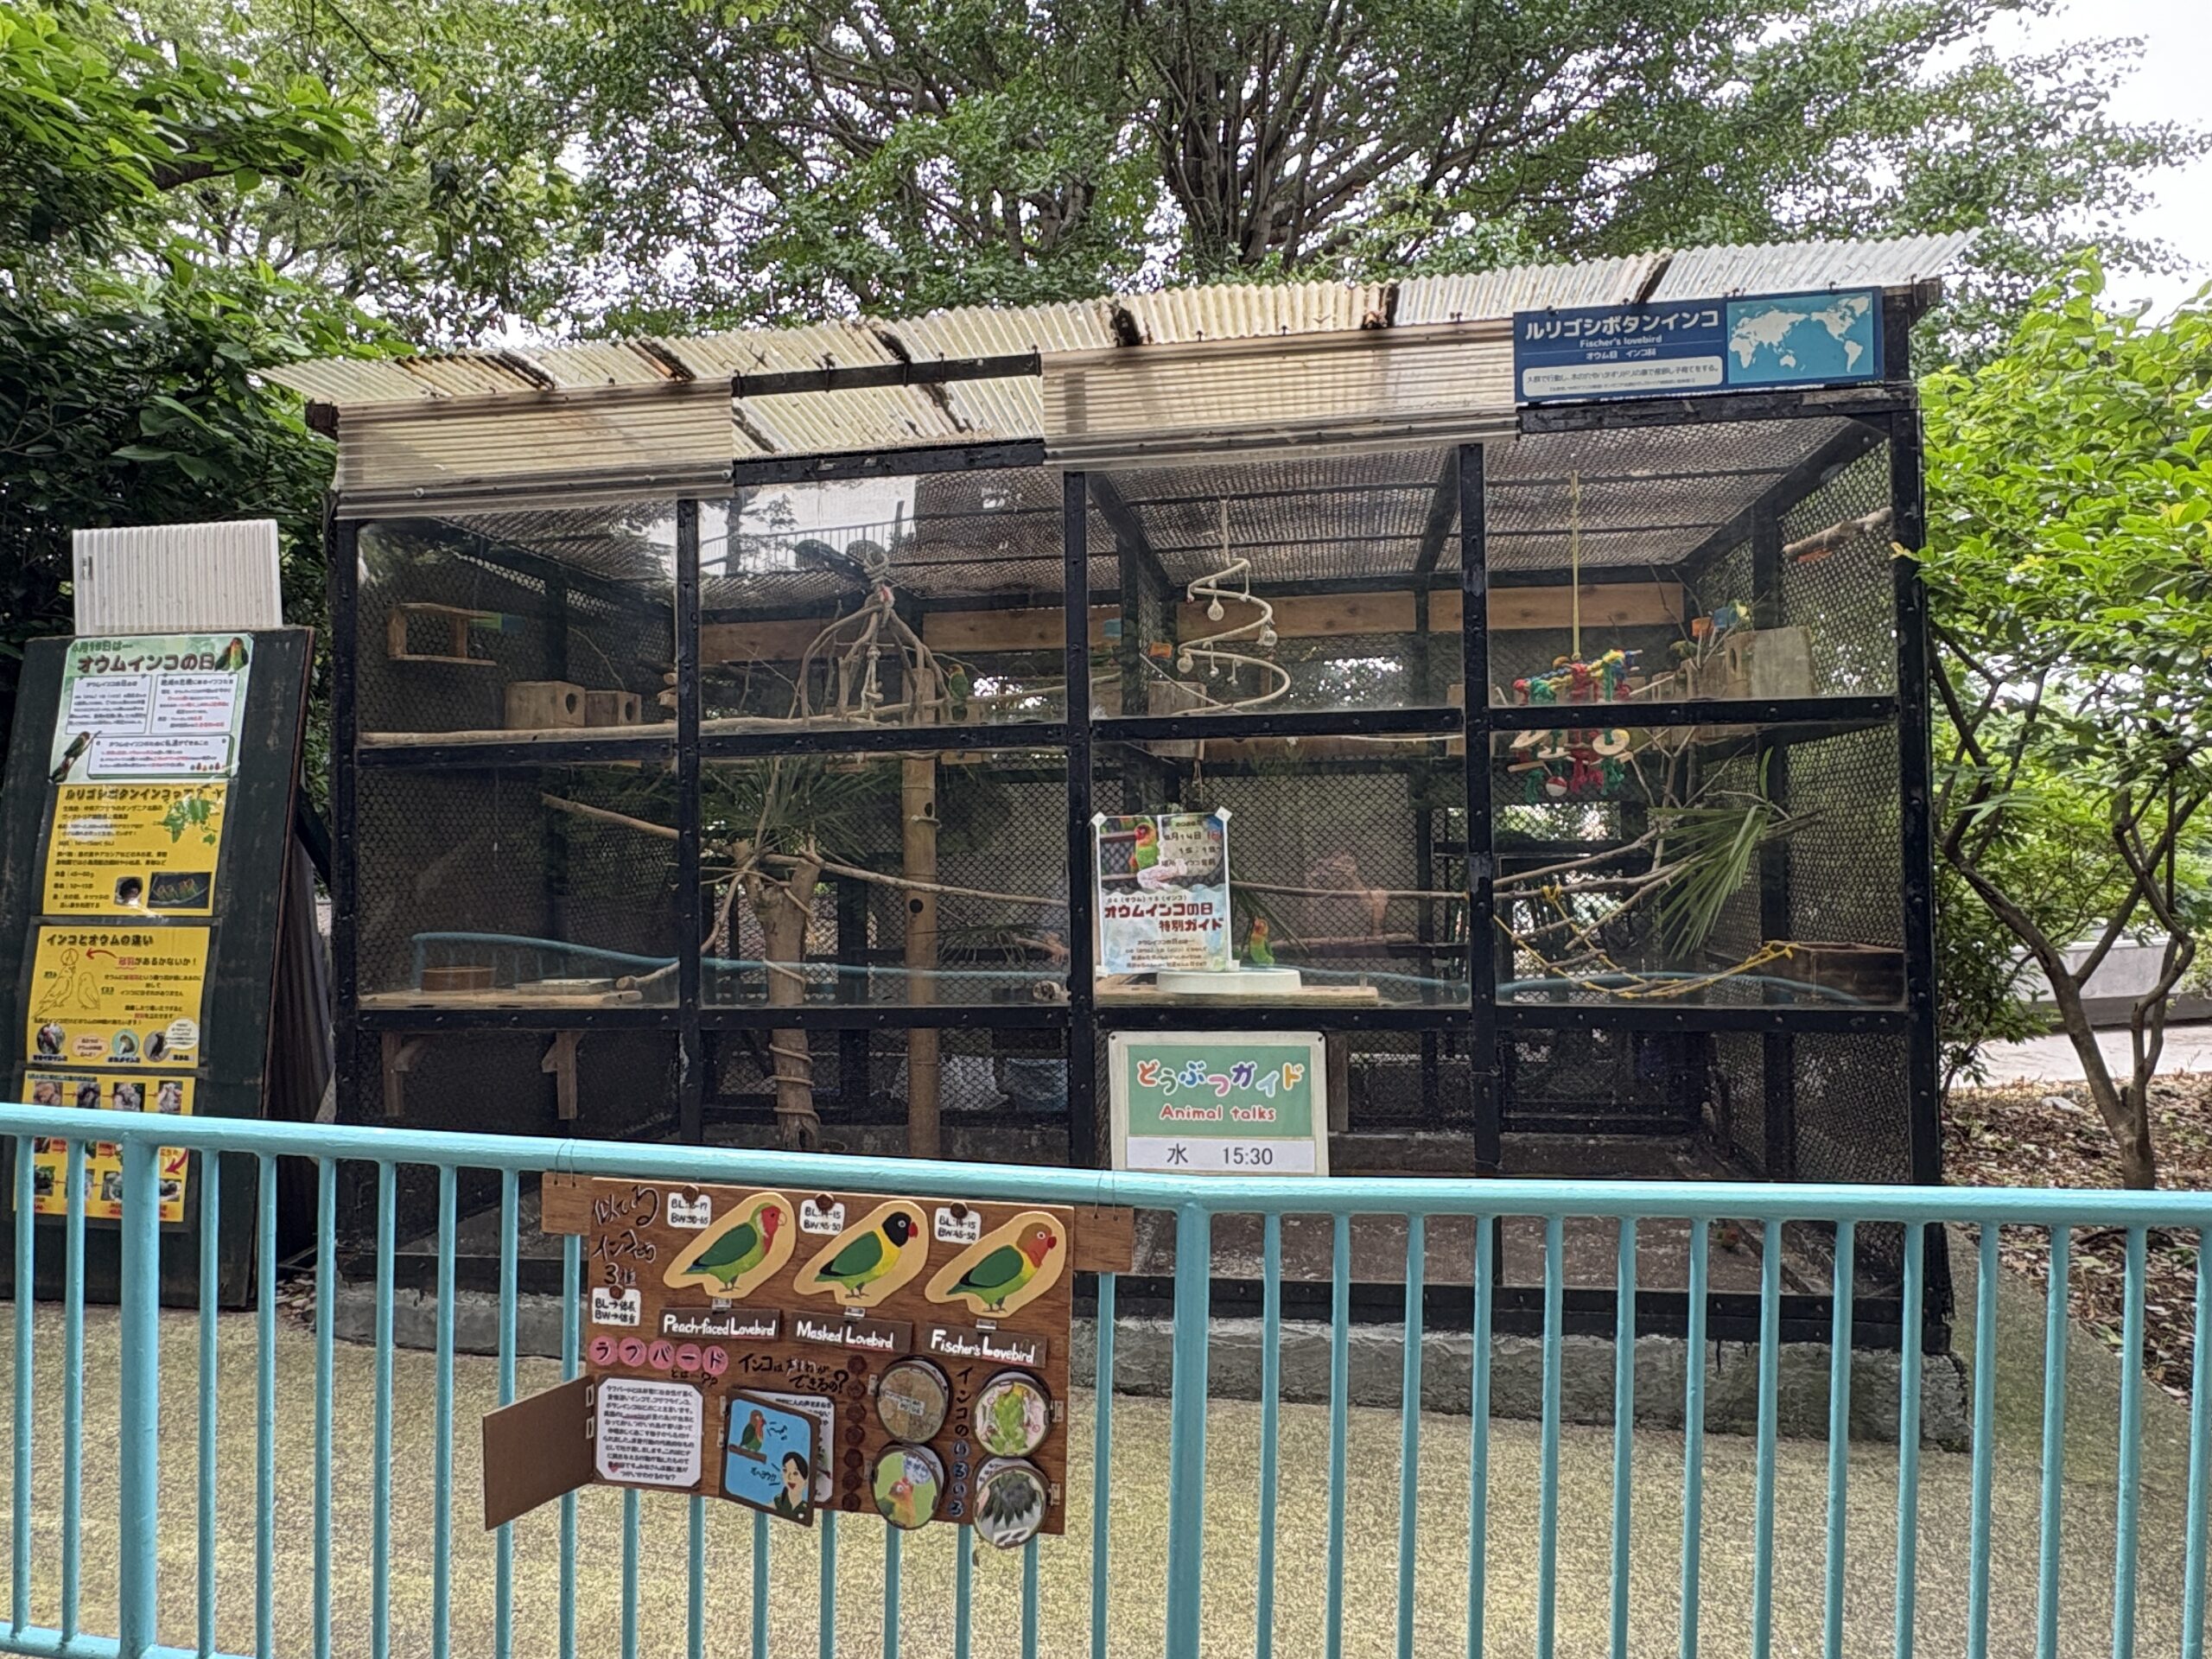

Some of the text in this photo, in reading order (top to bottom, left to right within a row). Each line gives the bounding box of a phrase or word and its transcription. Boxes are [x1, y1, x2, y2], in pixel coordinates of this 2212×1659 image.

[1525, 310, 1719, 340] ルリゴシボタンインコ
[1580, 334, 1662, 348] Fischer's lovebird
[1586, 350, 1618, 360] オウム目
[78, 653, 215, 673] オウムインコの日
[1104, 902, 1213, 918] オウムインコの日
[1159, 918, 1224, 932] 特別ガイド
[47, 933, 154, 947] インコとオウムの違い
[1137, 1059, 1305, 1097] どうぶつガイド
[1160, 1103, 1276, 1121] Animal talks
[1166, 1143, 1274, 1166] 水 15:30
[593, 1185, 659, 1228] 似ている
[592, 1230, 657, 1263] インコたち
[664, 1314, 776, 1337] Peach-faced Lovebird
[797, 1320, 894, 1350] Masked Lovebird
[595, 1342, 725, 1369] ラブバード
[931, 1329, 1036, 1364] Fischer's Lovebird
